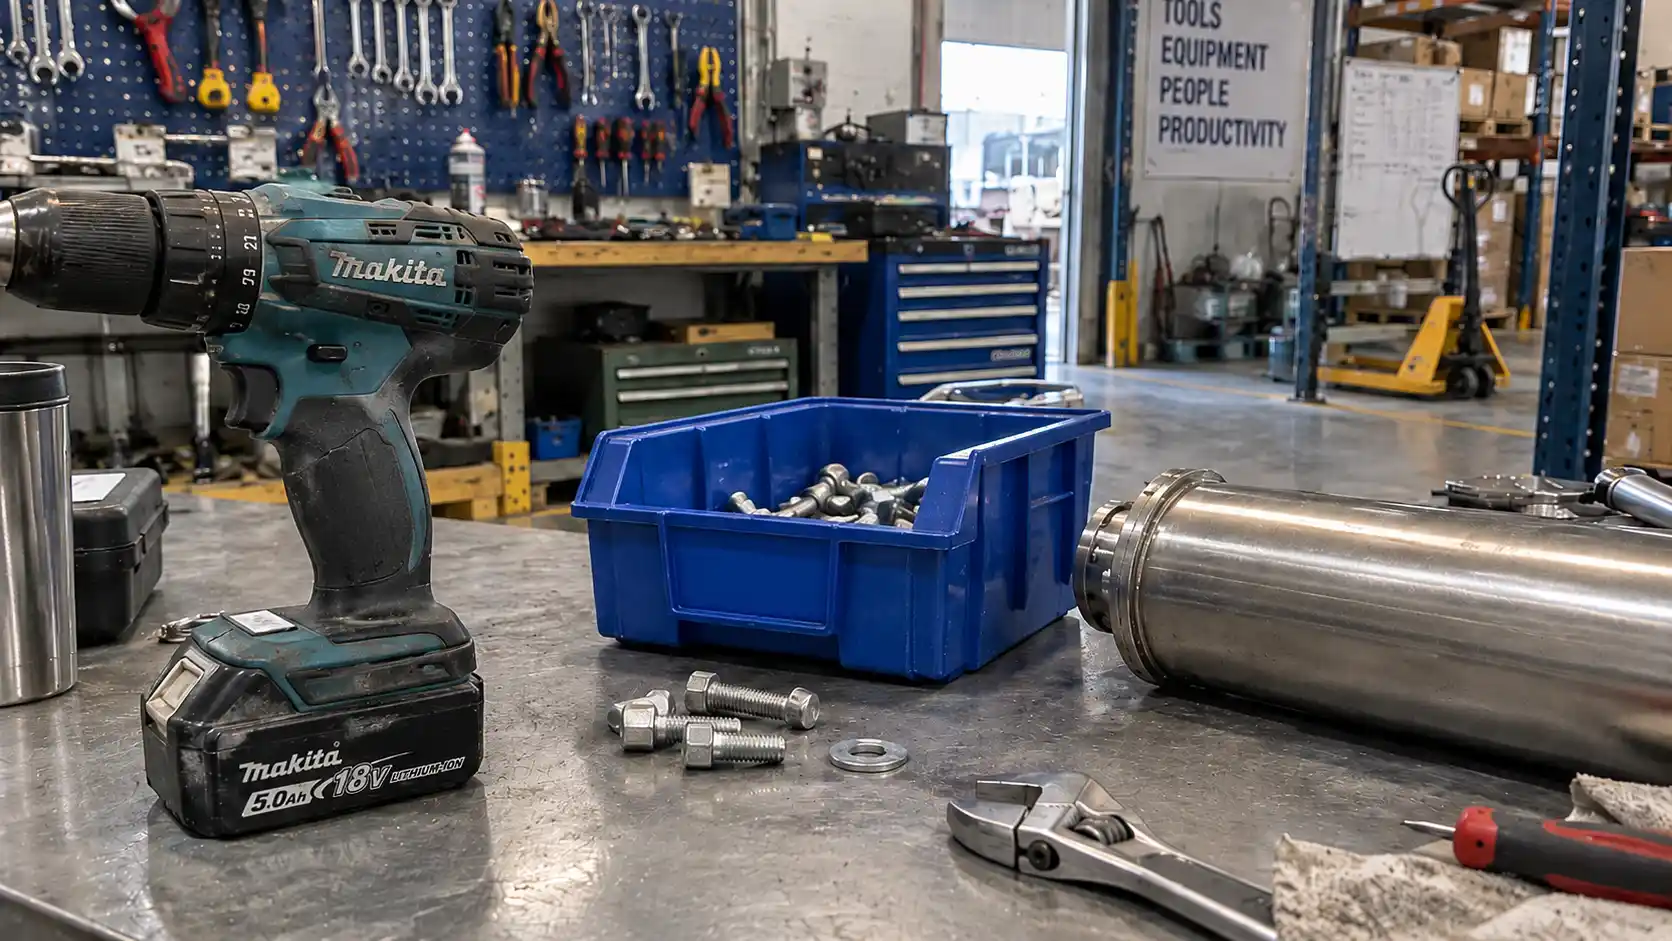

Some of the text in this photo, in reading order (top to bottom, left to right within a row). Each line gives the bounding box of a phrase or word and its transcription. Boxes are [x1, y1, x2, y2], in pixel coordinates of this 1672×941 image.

[1164, 0, 1222, 29] TOOLS
[1161, 35, 1269, 71] EQUIPMENT
[1159, 76, 1230, 107] PEOPLE
[1158, 115, 1287, 148] PRODUCTIVITY
[251, 757, 466, 812] 5.0Ah 18V LITHIUM-ION
